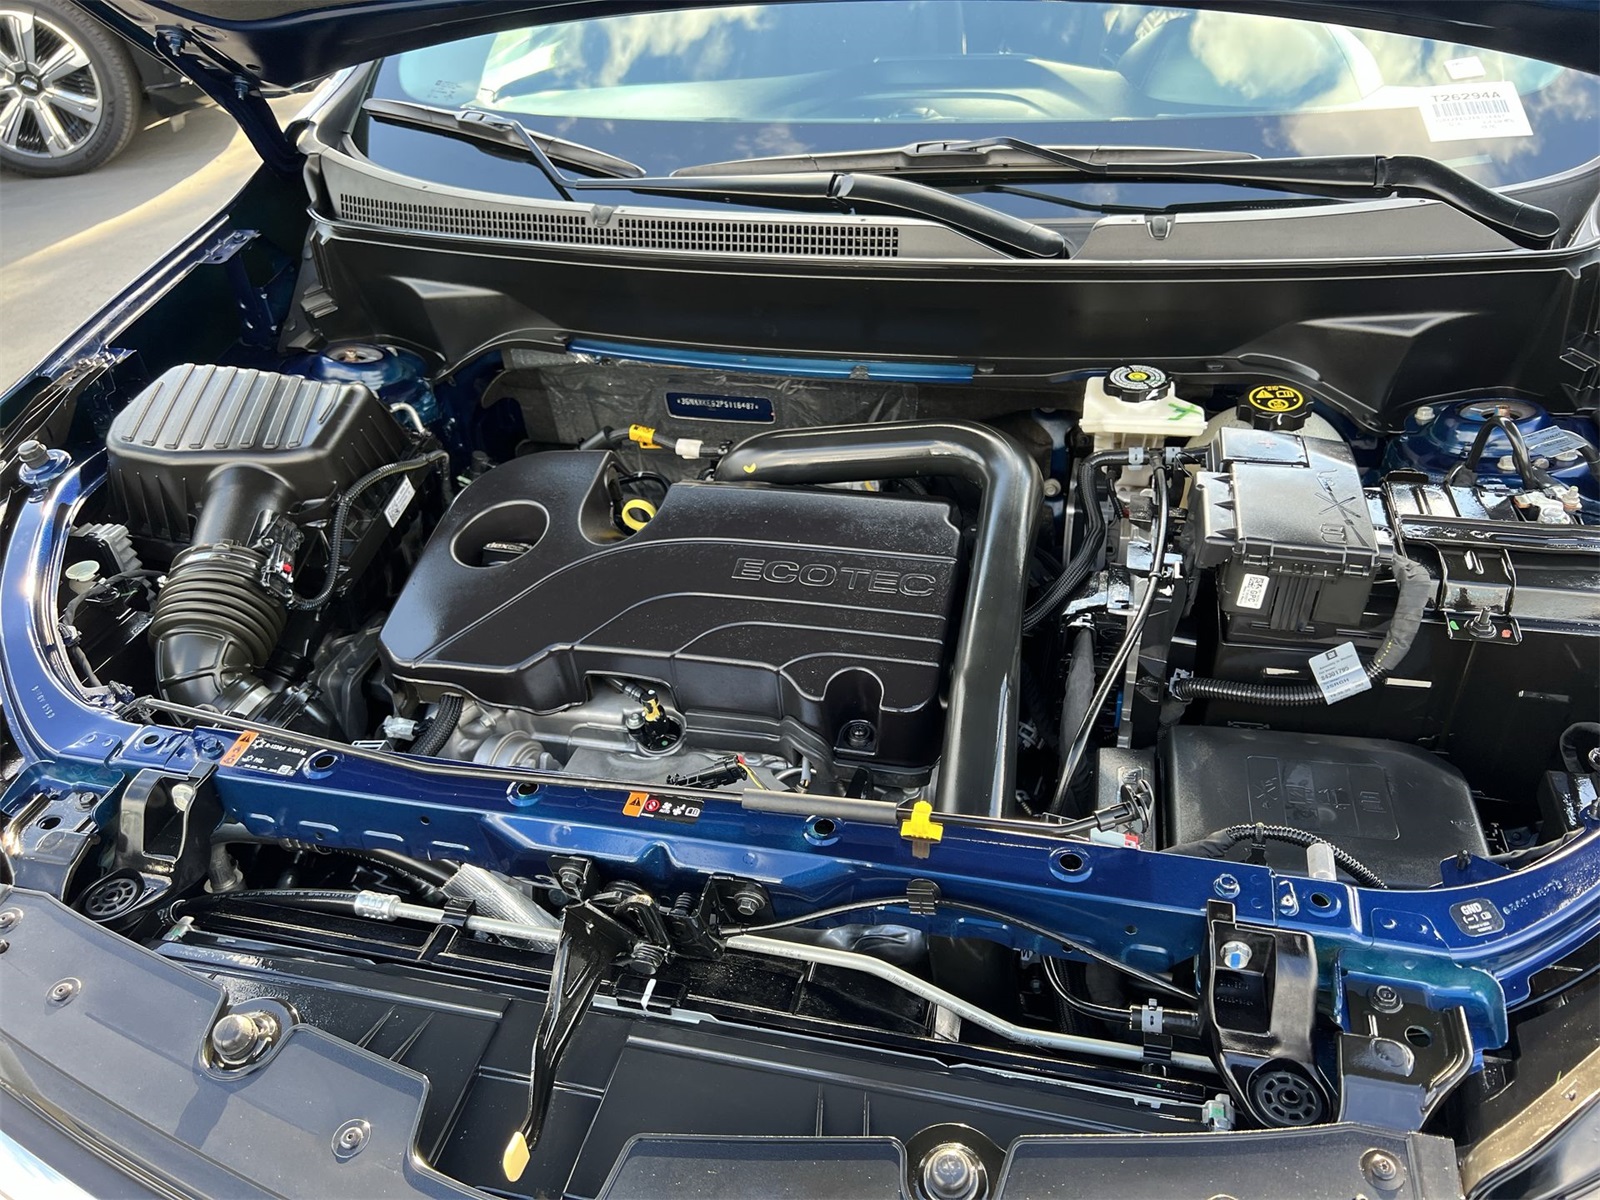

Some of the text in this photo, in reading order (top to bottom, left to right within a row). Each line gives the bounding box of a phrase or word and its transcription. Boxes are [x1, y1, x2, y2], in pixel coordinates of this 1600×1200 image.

[1431, 91, 1501, 102] T26294A
[731, 557, 936, 597] ECOTEC
[1460, 902, 1482, 915] GND
